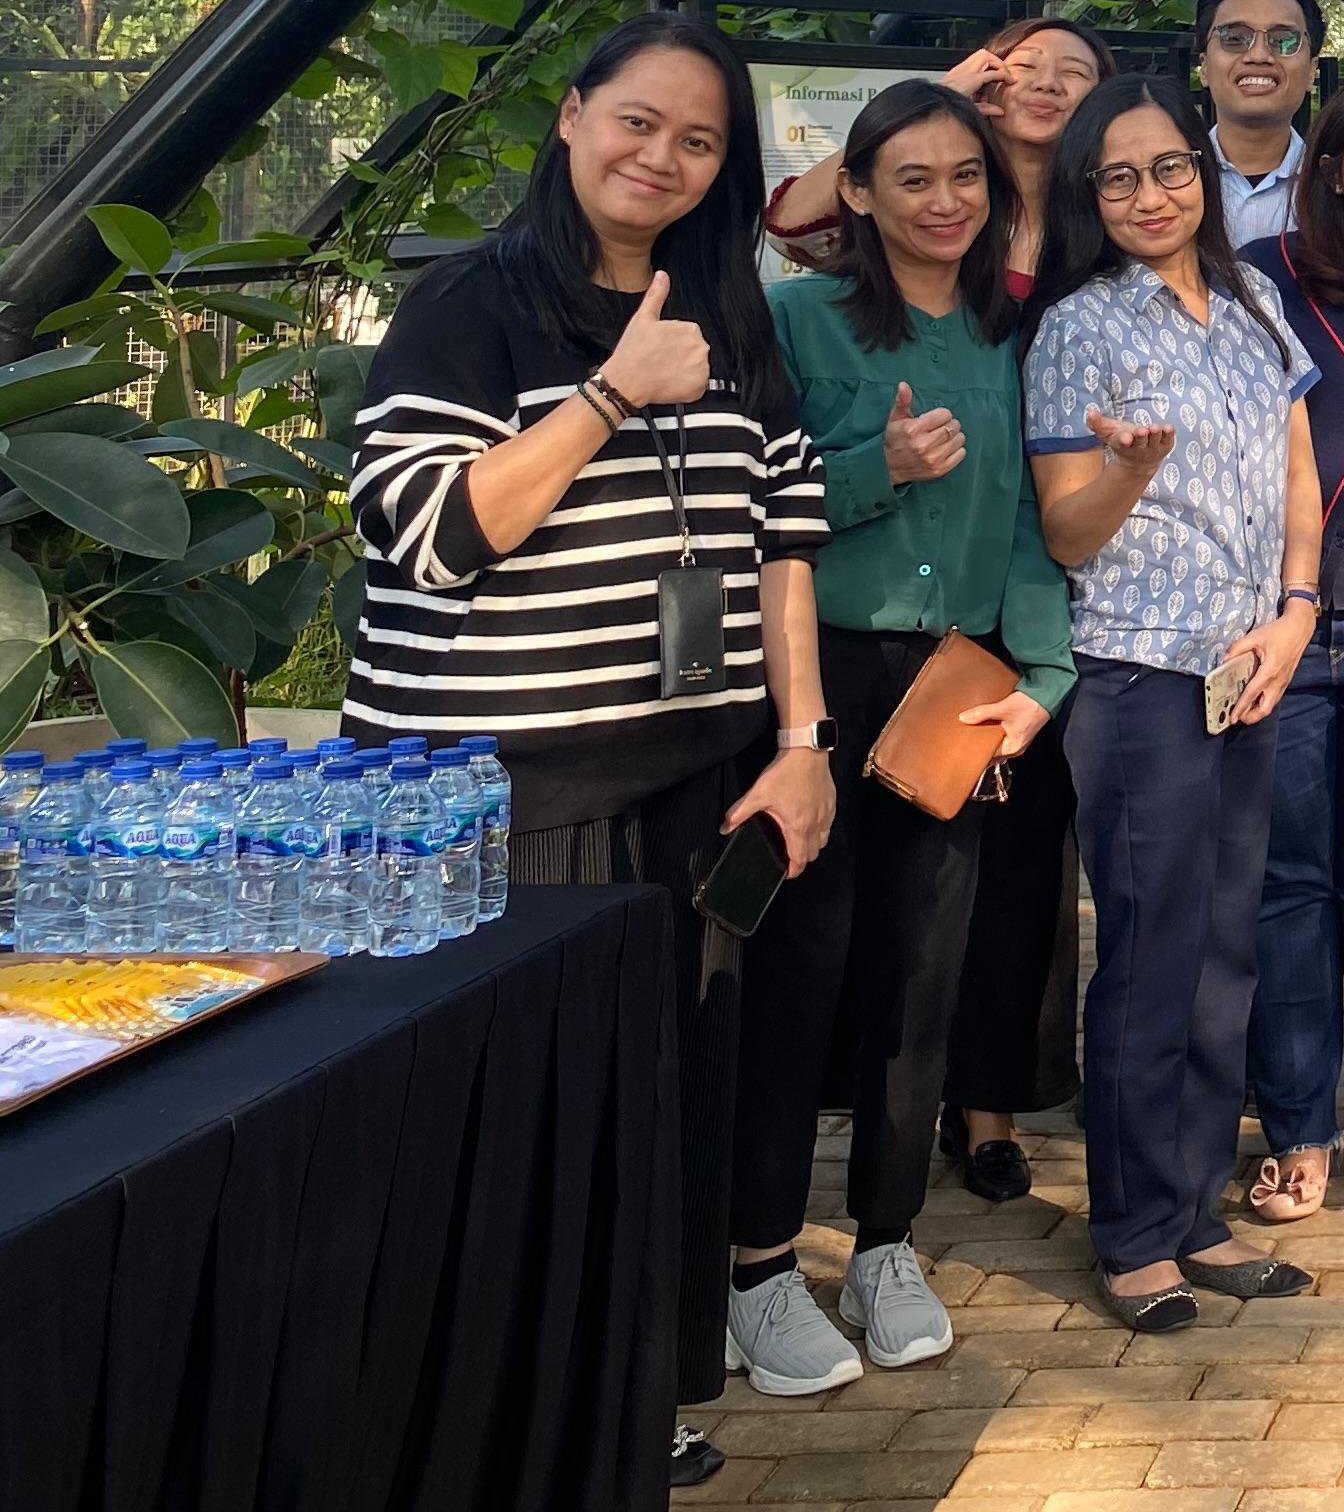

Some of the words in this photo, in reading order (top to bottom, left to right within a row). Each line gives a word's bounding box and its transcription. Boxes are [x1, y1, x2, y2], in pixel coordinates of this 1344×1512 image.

[785, 85, 863, 101] Informasi
[787, 125, 806, 143] 01
[165, 833, 197, 847] AQUA
